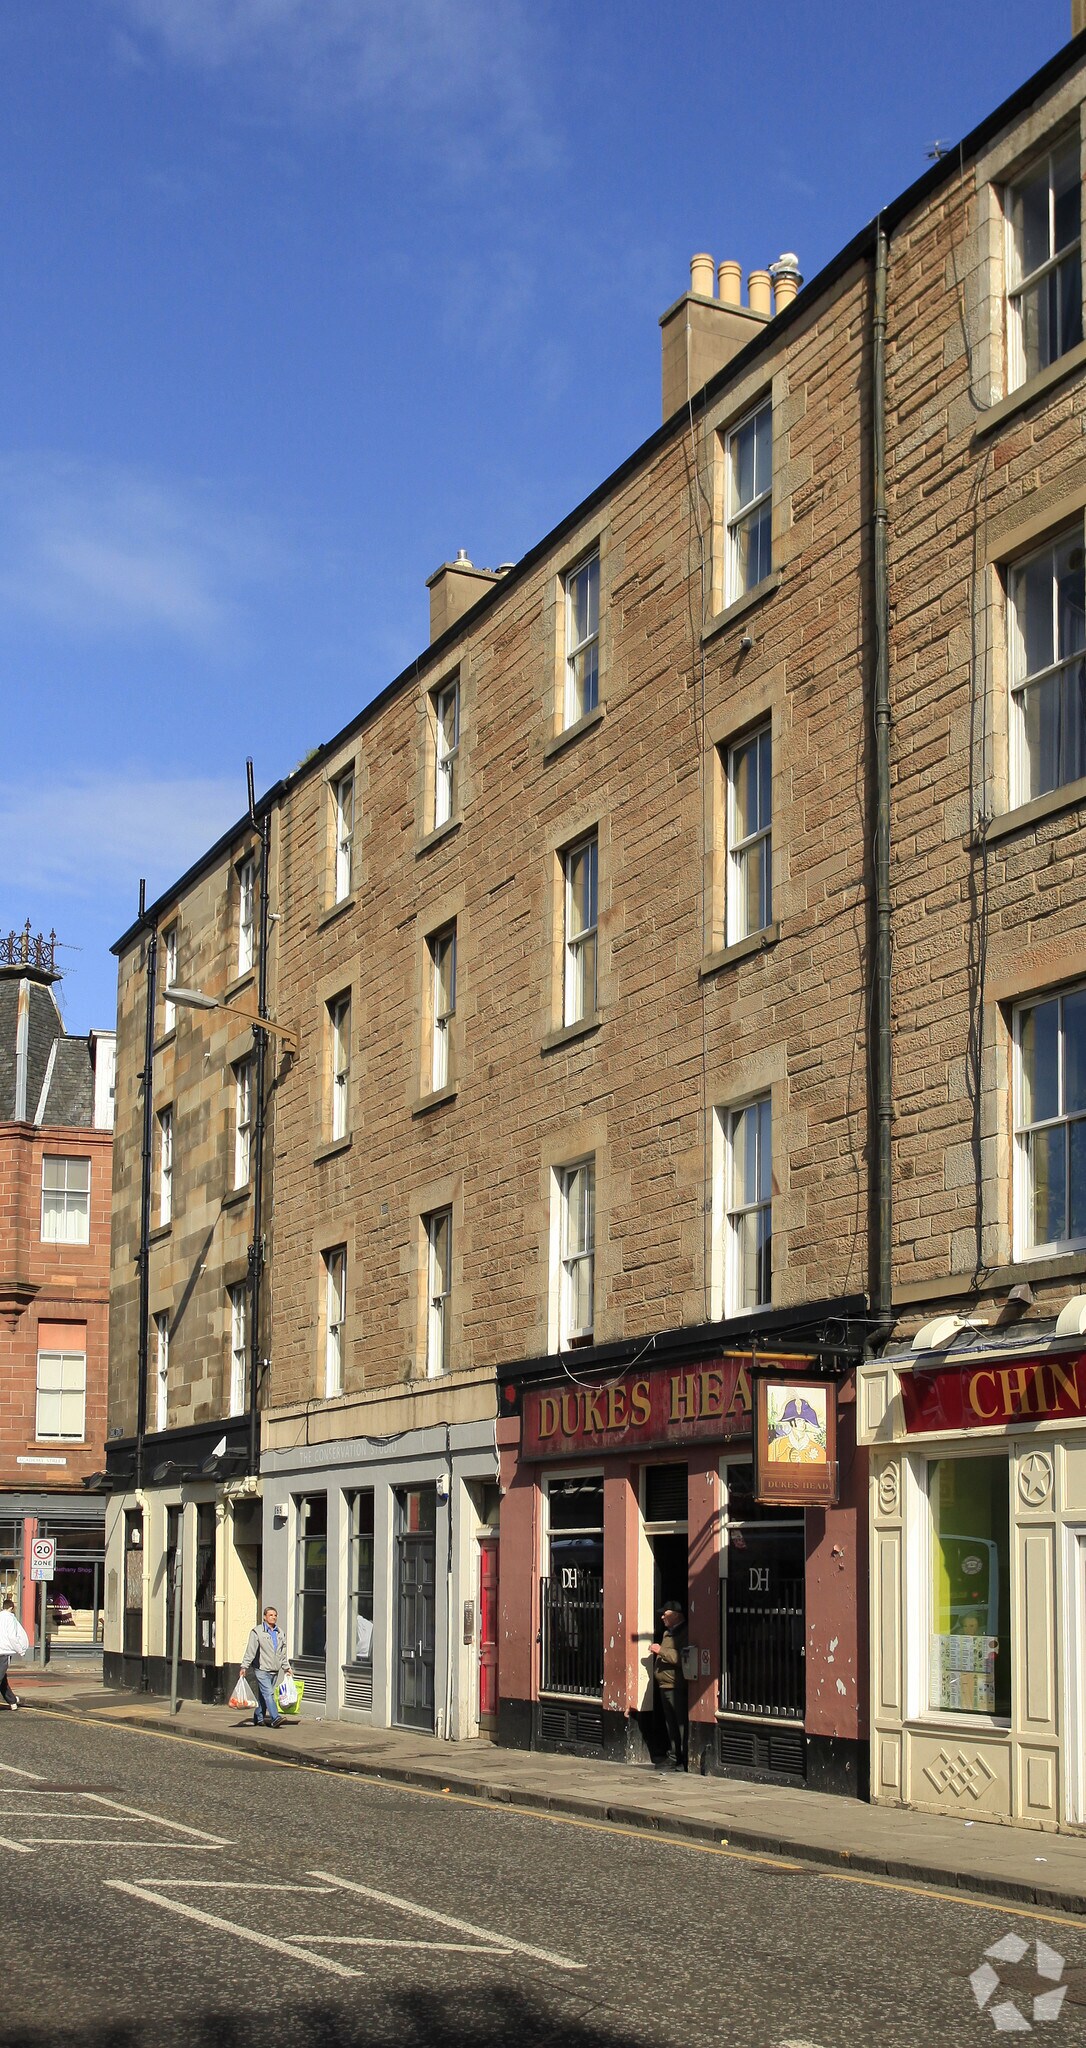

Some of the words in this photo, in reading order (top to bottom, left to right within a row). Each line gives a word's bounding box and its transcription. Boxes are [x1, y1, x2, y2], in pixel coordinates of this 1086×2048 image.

[539, 1381, 651, 1438] DUKES
[670, 1361, 785, 1423] HEA
[969, 1361, 1086, 1418] CHIN
[300, 1450, 312, 1464] THE
[315, 1443, 367, 1461] CONSERVATION
[371, 1441, 398, 1456] STUDIO
[768, 1481, 799, 1489] DUKES
[802, 1482, 828, 1490] HEAD
[36, 1545, 50, 1554] 20
[562, 1567, 578, 1588] DH
[749, 1568, 770, 1591] DH
